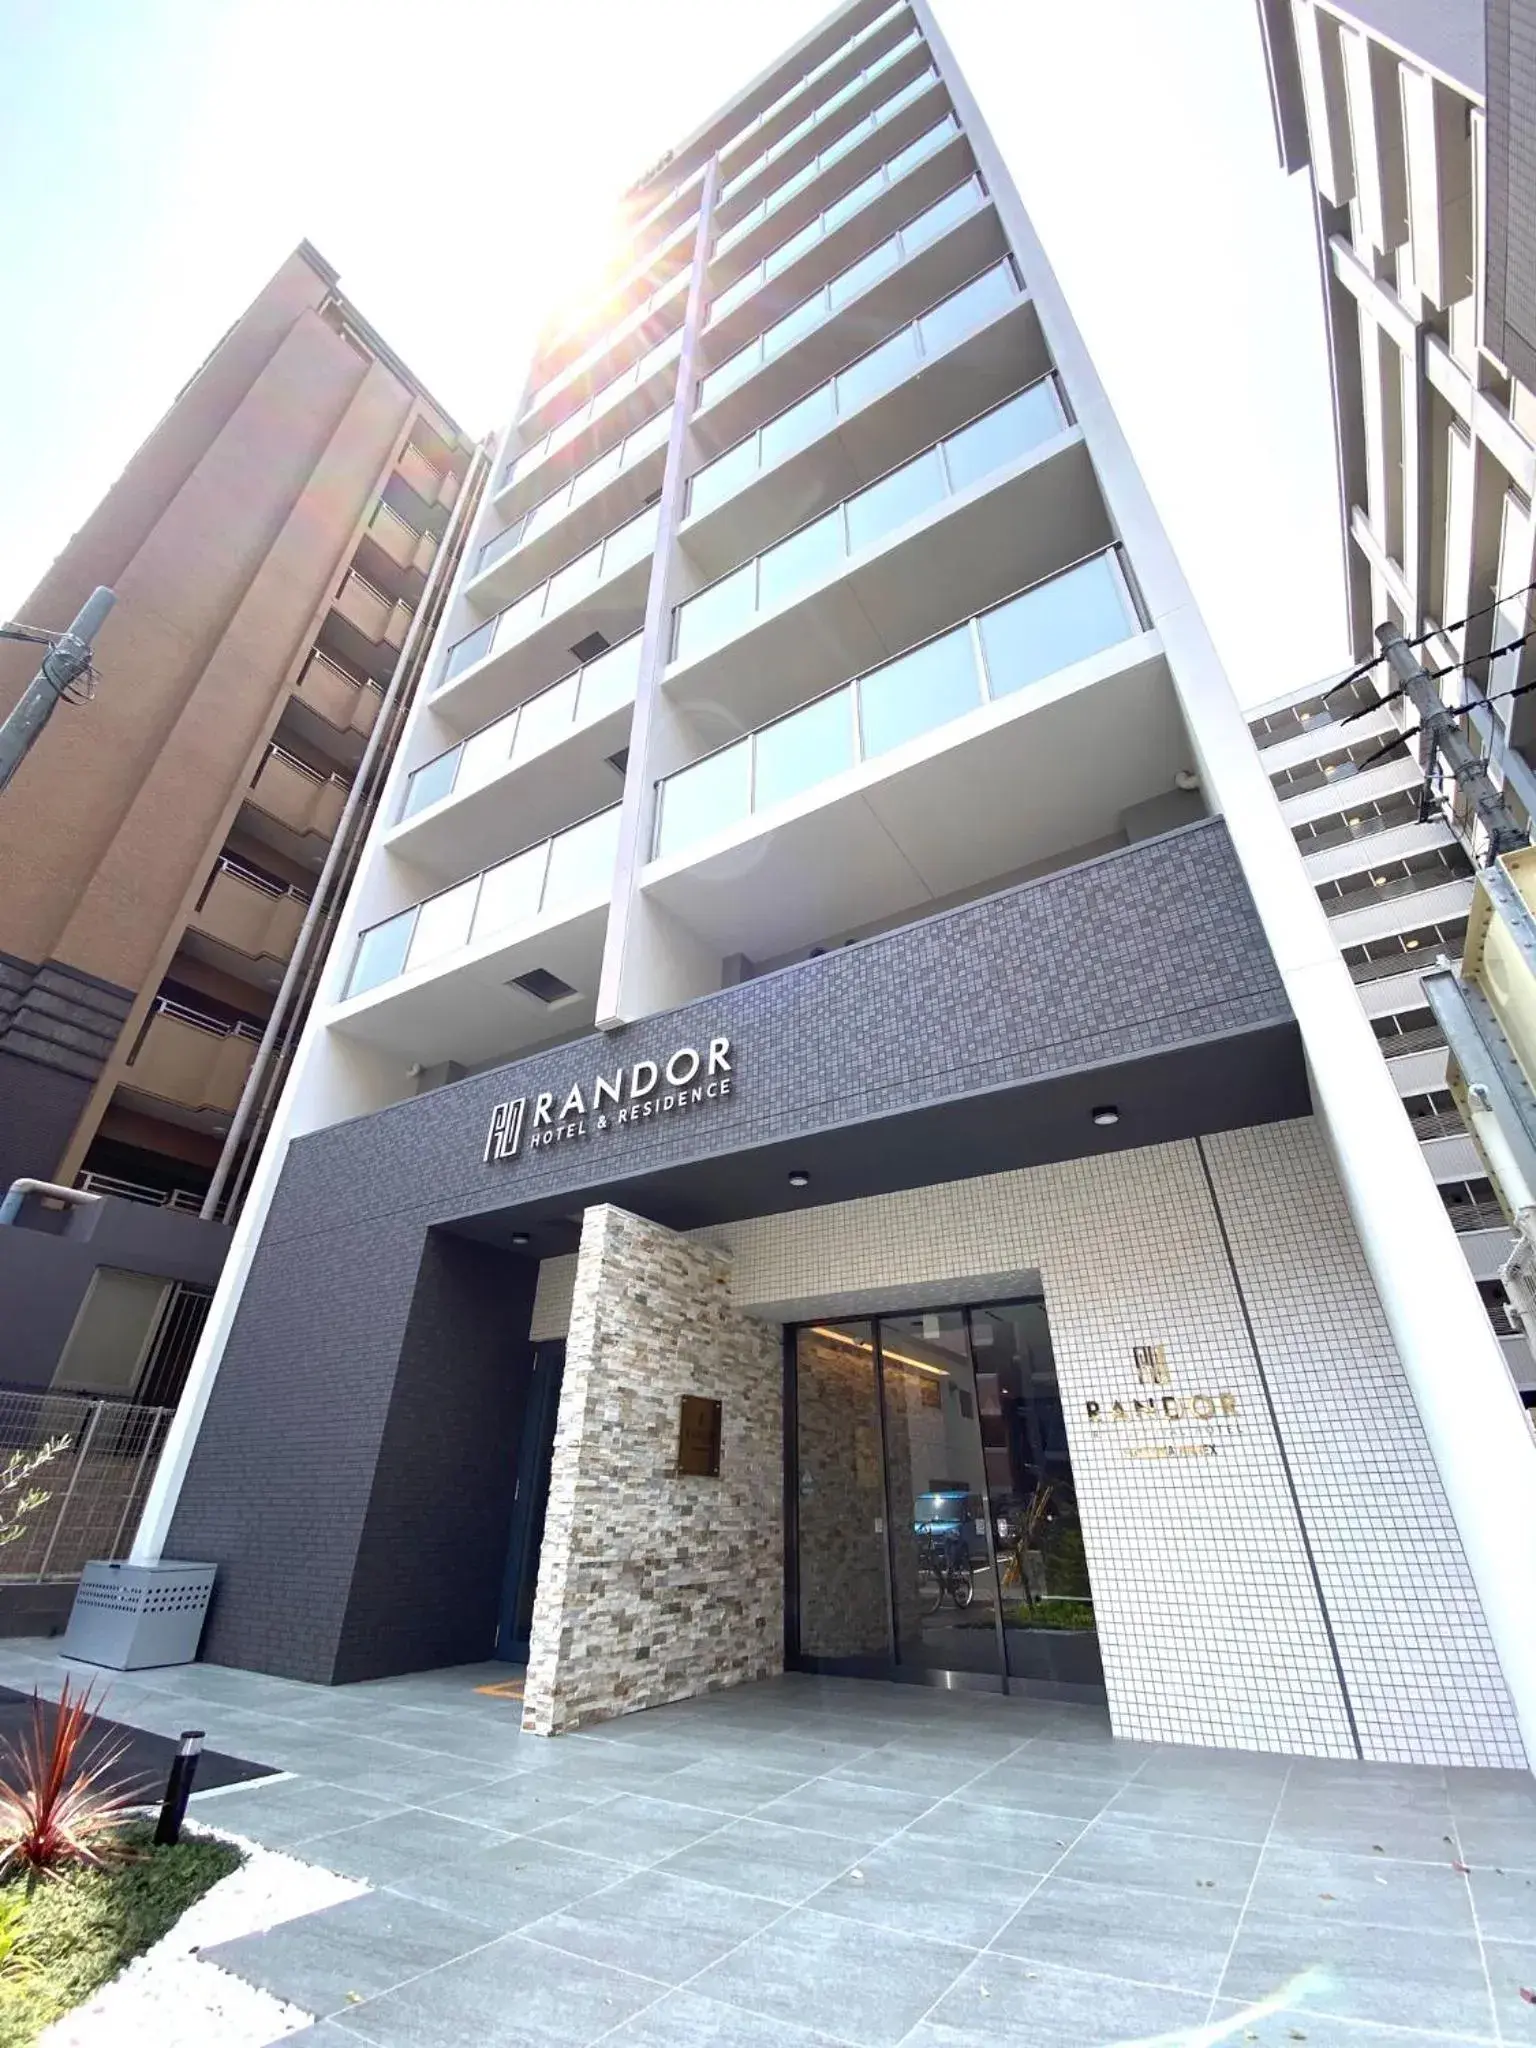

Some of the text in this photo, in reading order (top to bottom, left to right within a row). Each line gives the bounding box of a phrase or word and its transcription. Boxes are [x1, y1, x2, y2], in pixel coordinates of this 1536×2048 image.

[530, 1078, 732, 1149] HOTEL & RESIDENCE
[532, 1037, 732, 1127] RANDOR
[1086, 1393, 1237, 1422] RANDOR
